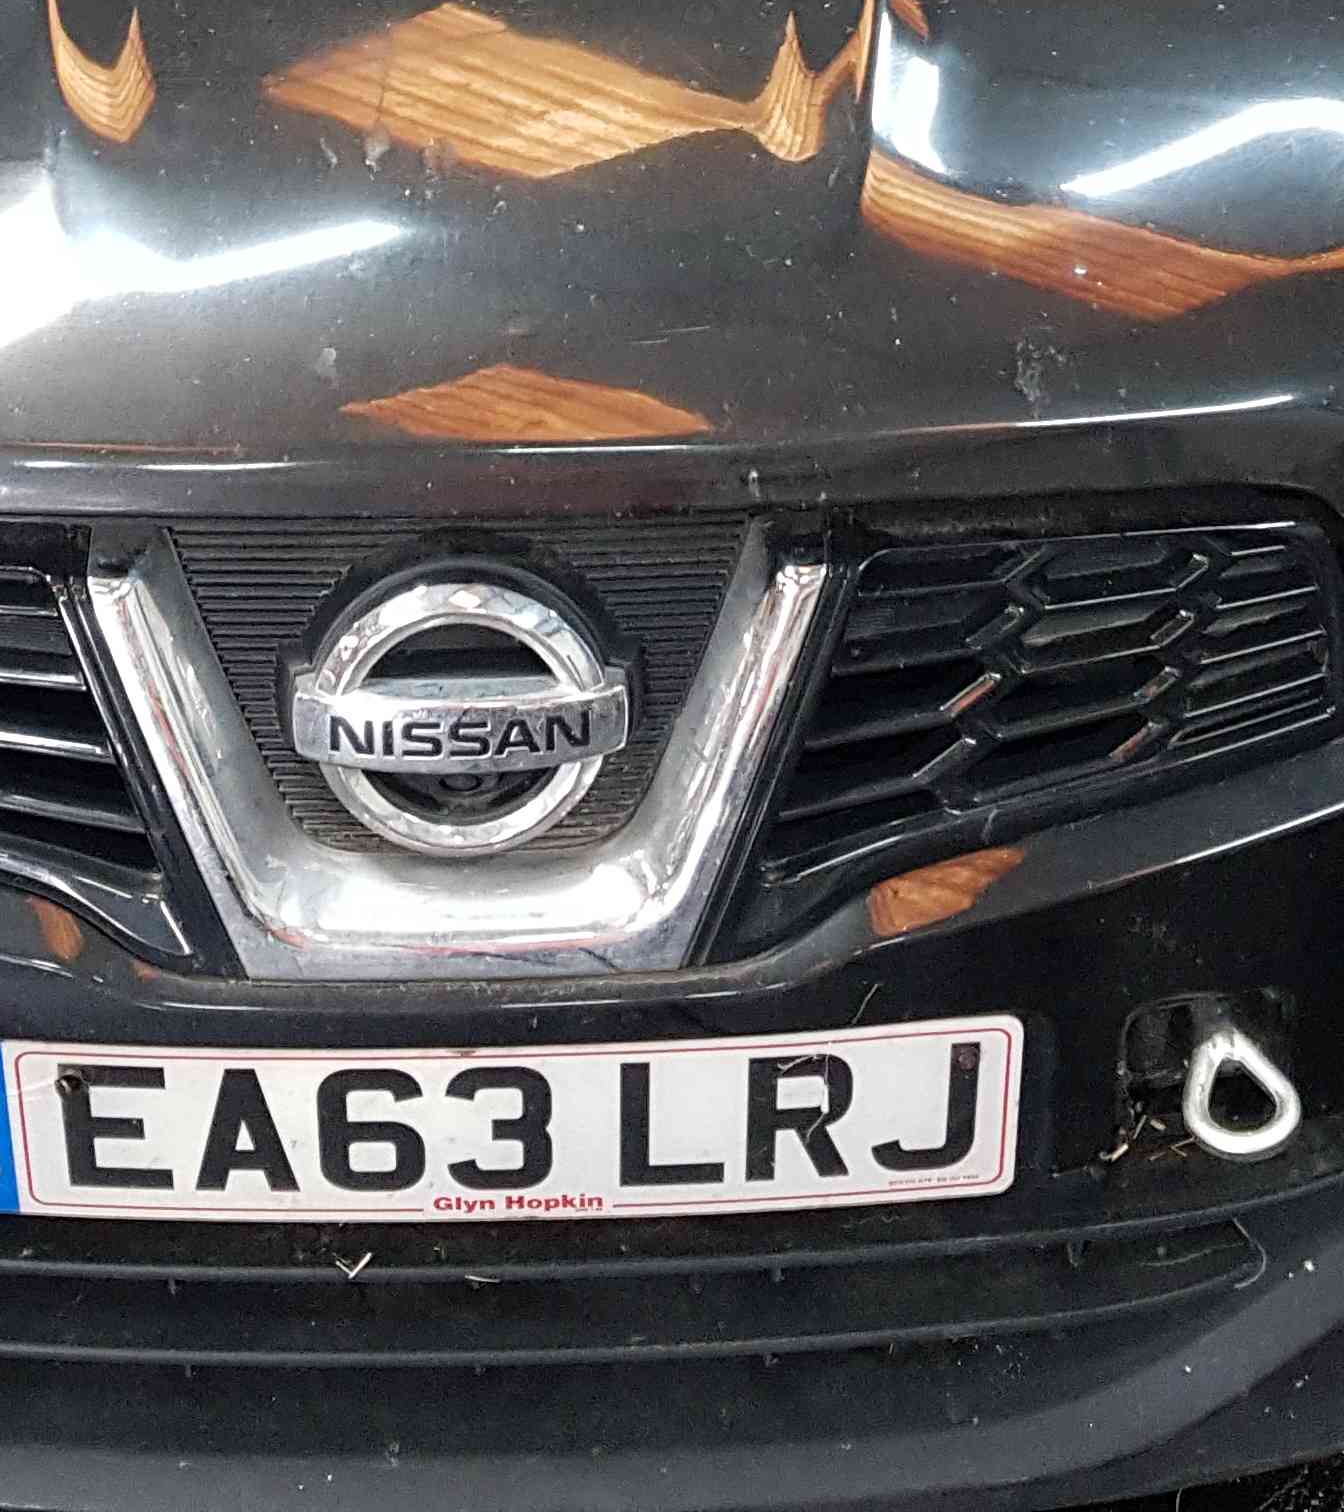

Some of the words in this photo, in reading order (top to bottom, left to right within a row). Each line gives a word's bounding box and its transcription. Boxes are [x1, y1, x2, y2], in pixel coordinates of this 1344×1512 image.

[328, 708, 593, 758] NISSAN
[56, 1062, 555, 1193] EA63
[619, 1042, 982, 1187] LRJ
[433, 1196, 496, 1214] Glyn
[505, 1193, 604, 1212] Hopkin
